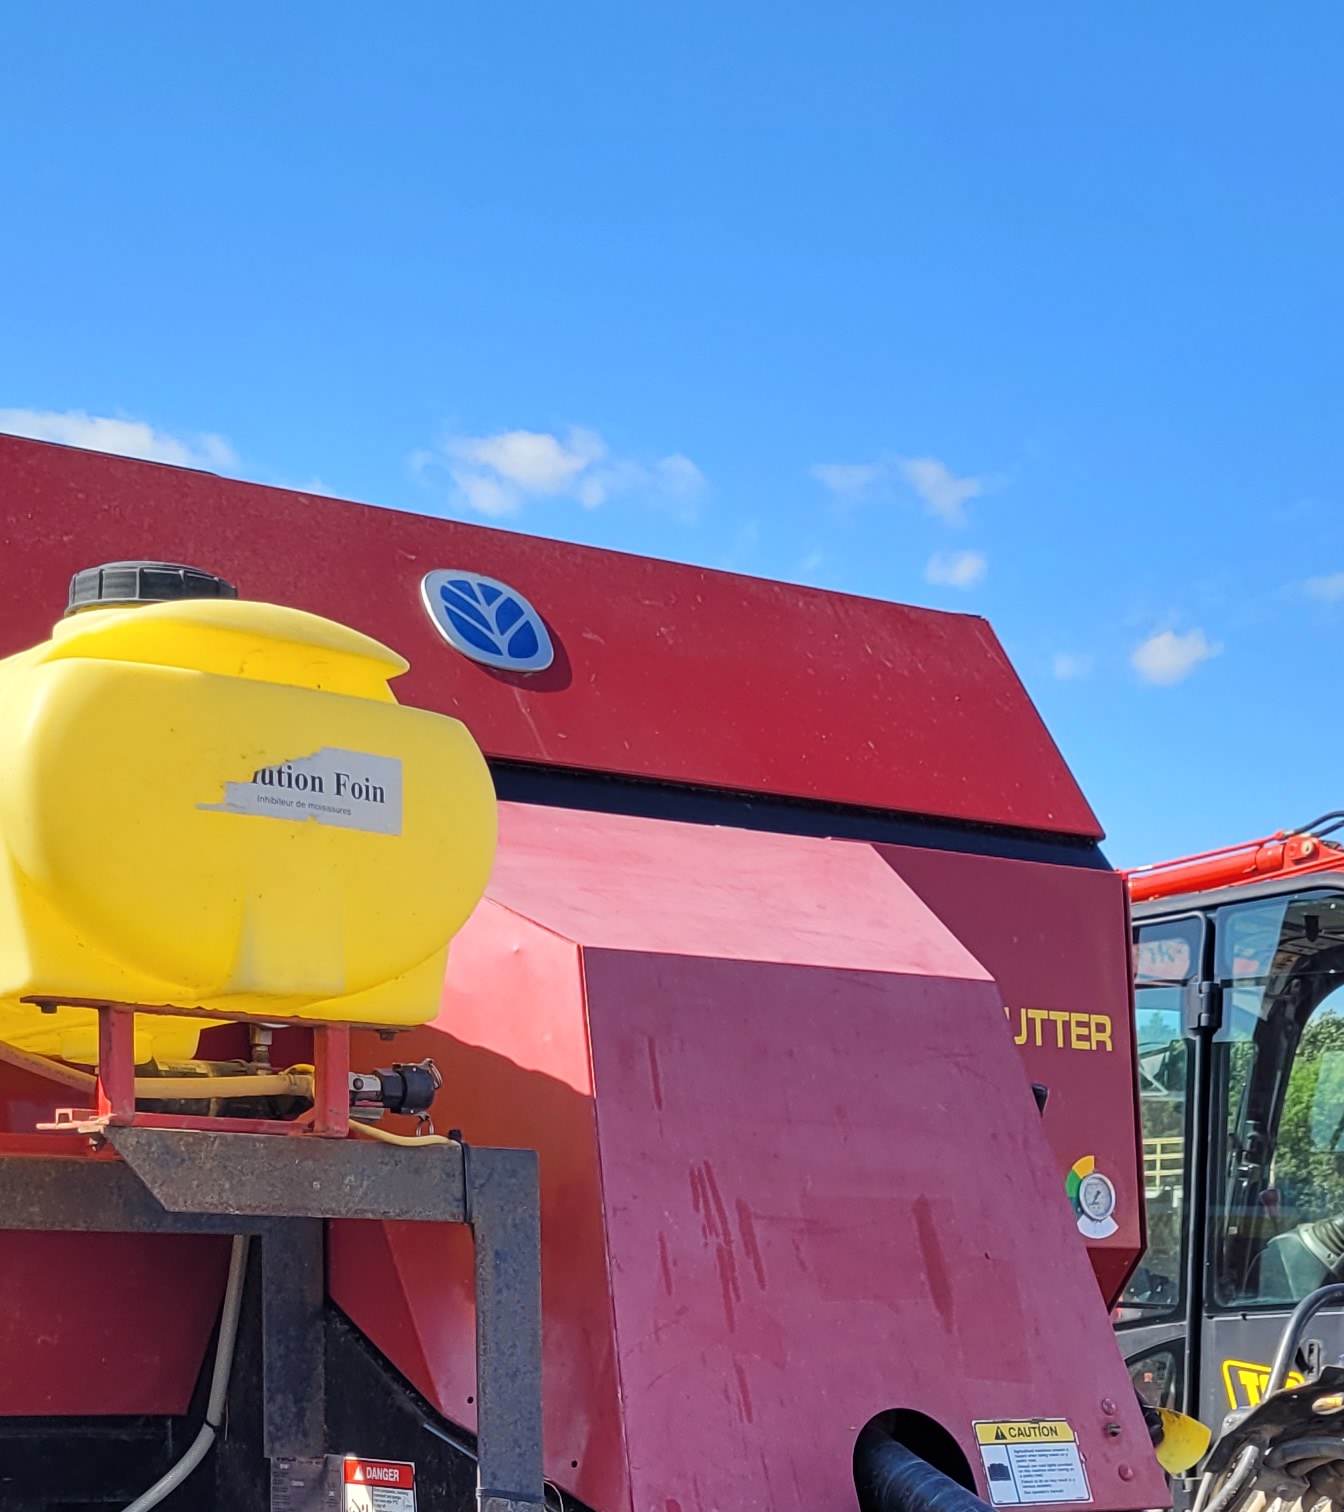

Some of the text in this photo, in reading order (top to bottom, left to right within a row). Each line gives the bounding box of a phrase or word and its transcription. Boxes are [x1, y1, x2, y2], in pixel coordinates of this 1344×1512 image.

[334, 772, 385, 803] Foin
[257, 795, 351, 815] Inhibiteur de moisissures
[1008, 1425, 1059, 1438] CAUTION
[365, 1466, 400, 1482] DANGER
